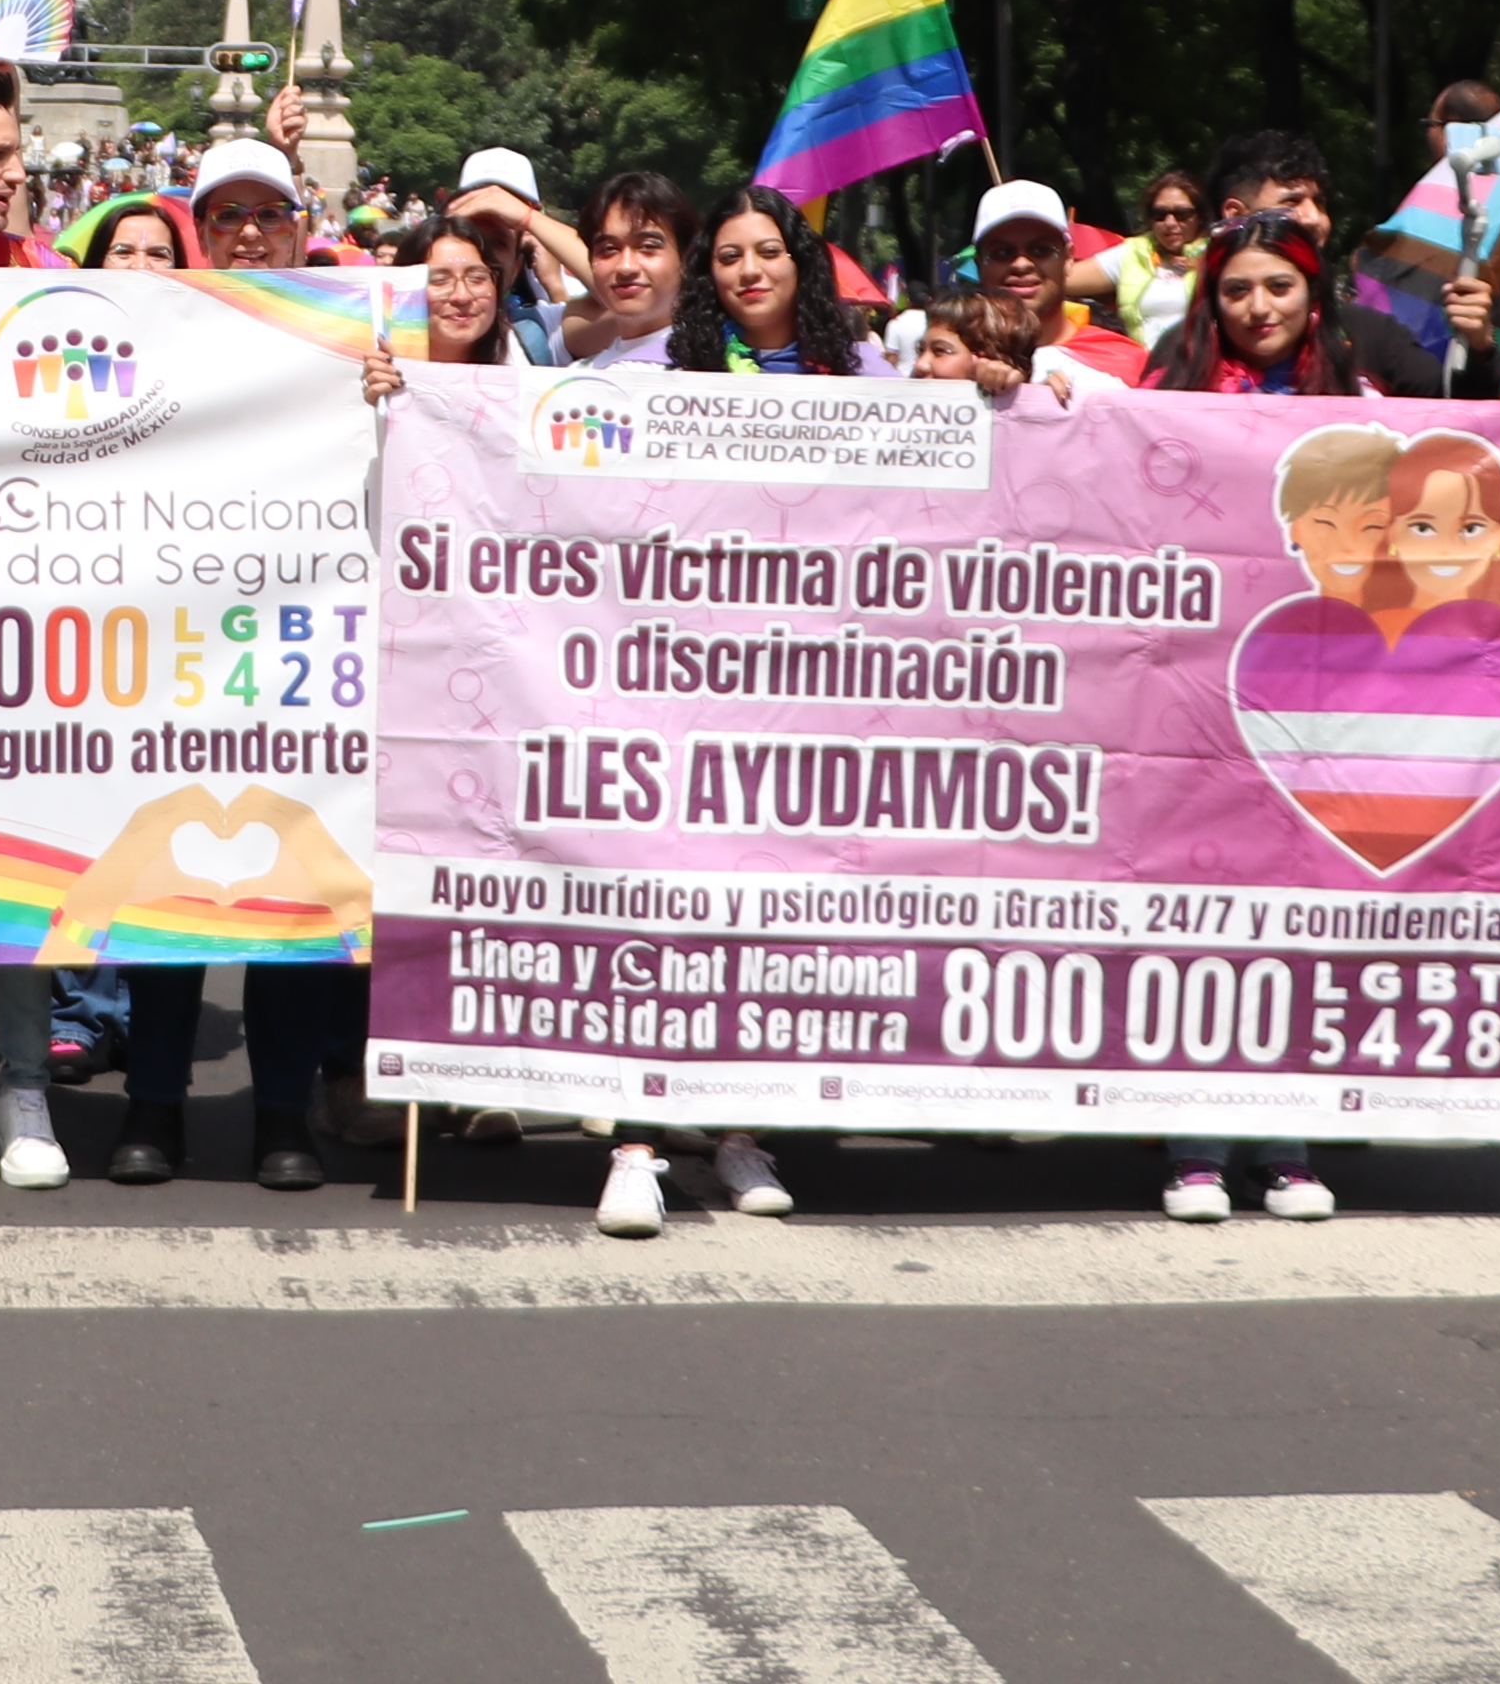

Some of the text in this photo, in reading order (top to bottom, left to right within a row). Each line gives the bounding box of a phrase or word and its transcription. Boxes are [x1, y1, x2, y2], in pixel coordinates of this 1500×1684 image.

[11, 379, 165, 440] CONSEJO CIUDADANO
[21, 400, 182, 465] Ciudad de México
[33, 440, 59, 450] para
[60, 440, 70, 449] la
[73, 426, 127, 449] Seguridad
[136, 396, 168, 428] Justicia
[646, 419, 977, 446] PARA LA SEGURIDAD Y JUSTICIA
[647, 395, 977, 426] CONSEJO CIUDADANO
[646, 442, 976, 469] DE LA CIUDAD DE MÉXICO
[143, 488, 369, 531] Nacional
[156, 544, 369, 596] Segura
[399, 523, 1215, 622] Si eres víctima de violencia
[174, 604, 367, 644] LGBT
[173, 650, 366, 708] 5428
[562, 624, 1058, 705] o discriminación
[131, 720, 369, 775] atenderte
[522, 736, 1094, 835] ¡LES AYUDAMOS!
[431, 865, 548, 914] Apoyo
[561, 872, 712, 921] jurídico
[724, 888, 745, 925] y
[760, 880, 979, 930] psicológico
[992, 889, 1131, 938] ¡Gratis,
[1145, 894, 1235, 936] 24/7
[1249, 903, 1271, 940] y
[448, 928, 562, 981] Línea
[573, 945, 598, 991] y
[738, 945, 918, 998] Nacional
[449, 985, 909, 1056] Diversidad Segura
[941, 947, 1293, 1064] 800 000
[409, 1060, 622, 1093] consejociudadanomx.org
[672, 1078, 798, 1098] @elconsejomx
[847, 1082, 1052, 1103] @consejociudadanomx
[1104, 1086, 1320, 1110] @ConsejoCiudadanoMx
